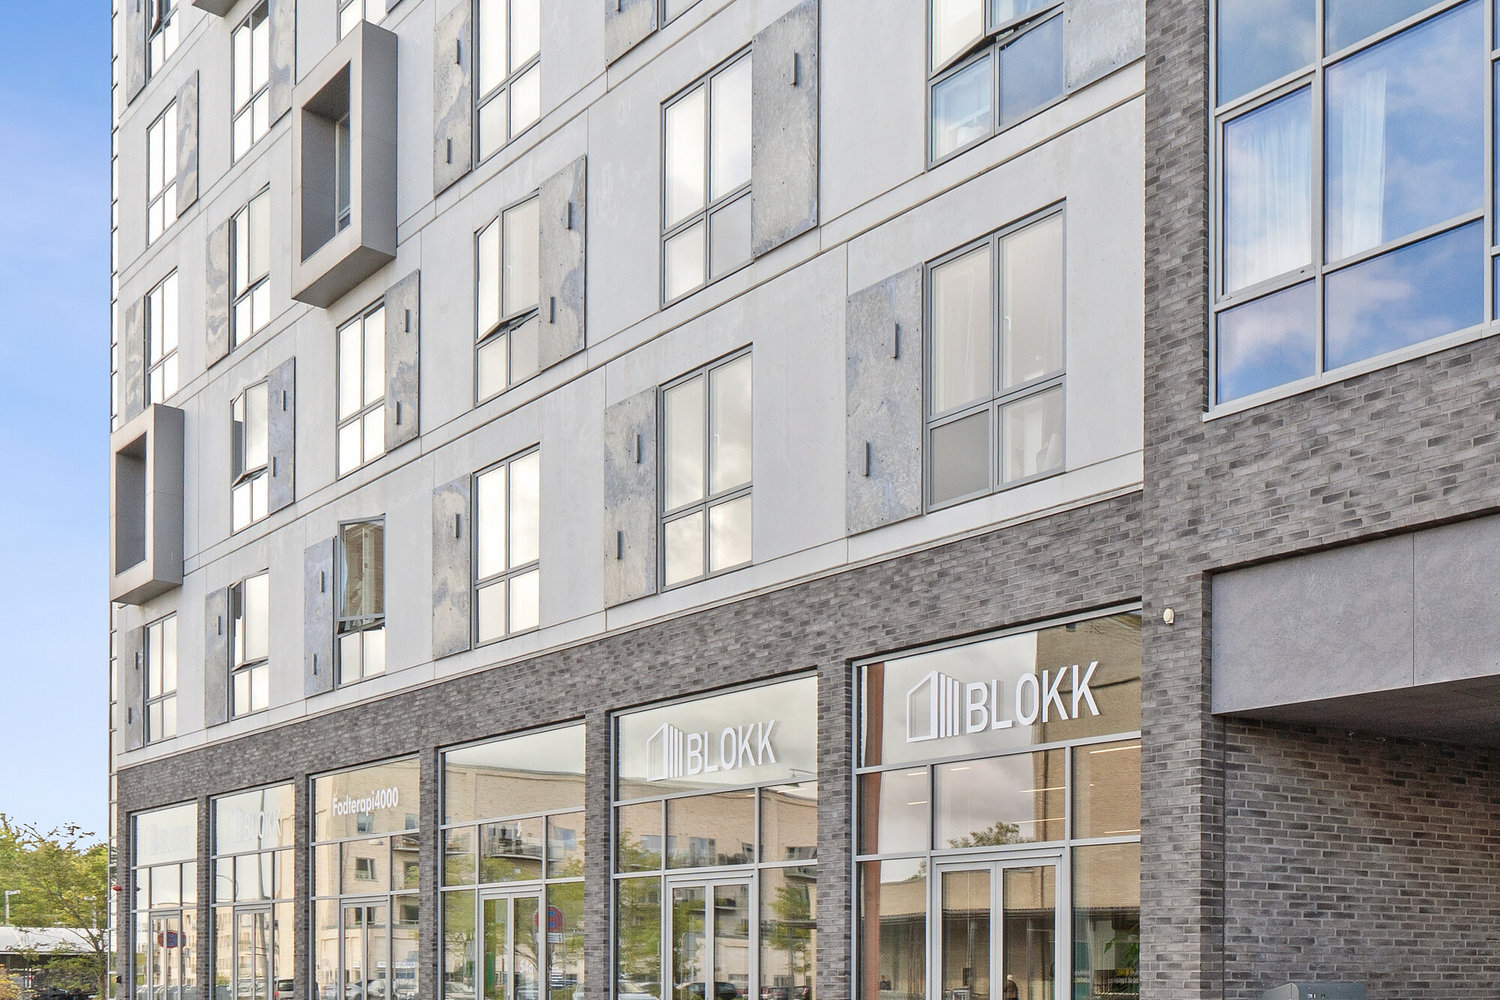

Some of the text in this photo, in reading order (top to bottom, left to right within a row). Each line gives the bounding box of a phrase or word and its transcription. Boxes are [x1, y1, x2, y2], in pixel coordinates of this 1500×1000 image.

[966, 660, 1100, 734] BLOKK
[687, 719, 777, 776] BLOKK
[332, 787, 399, 817] Fodterapi4000
